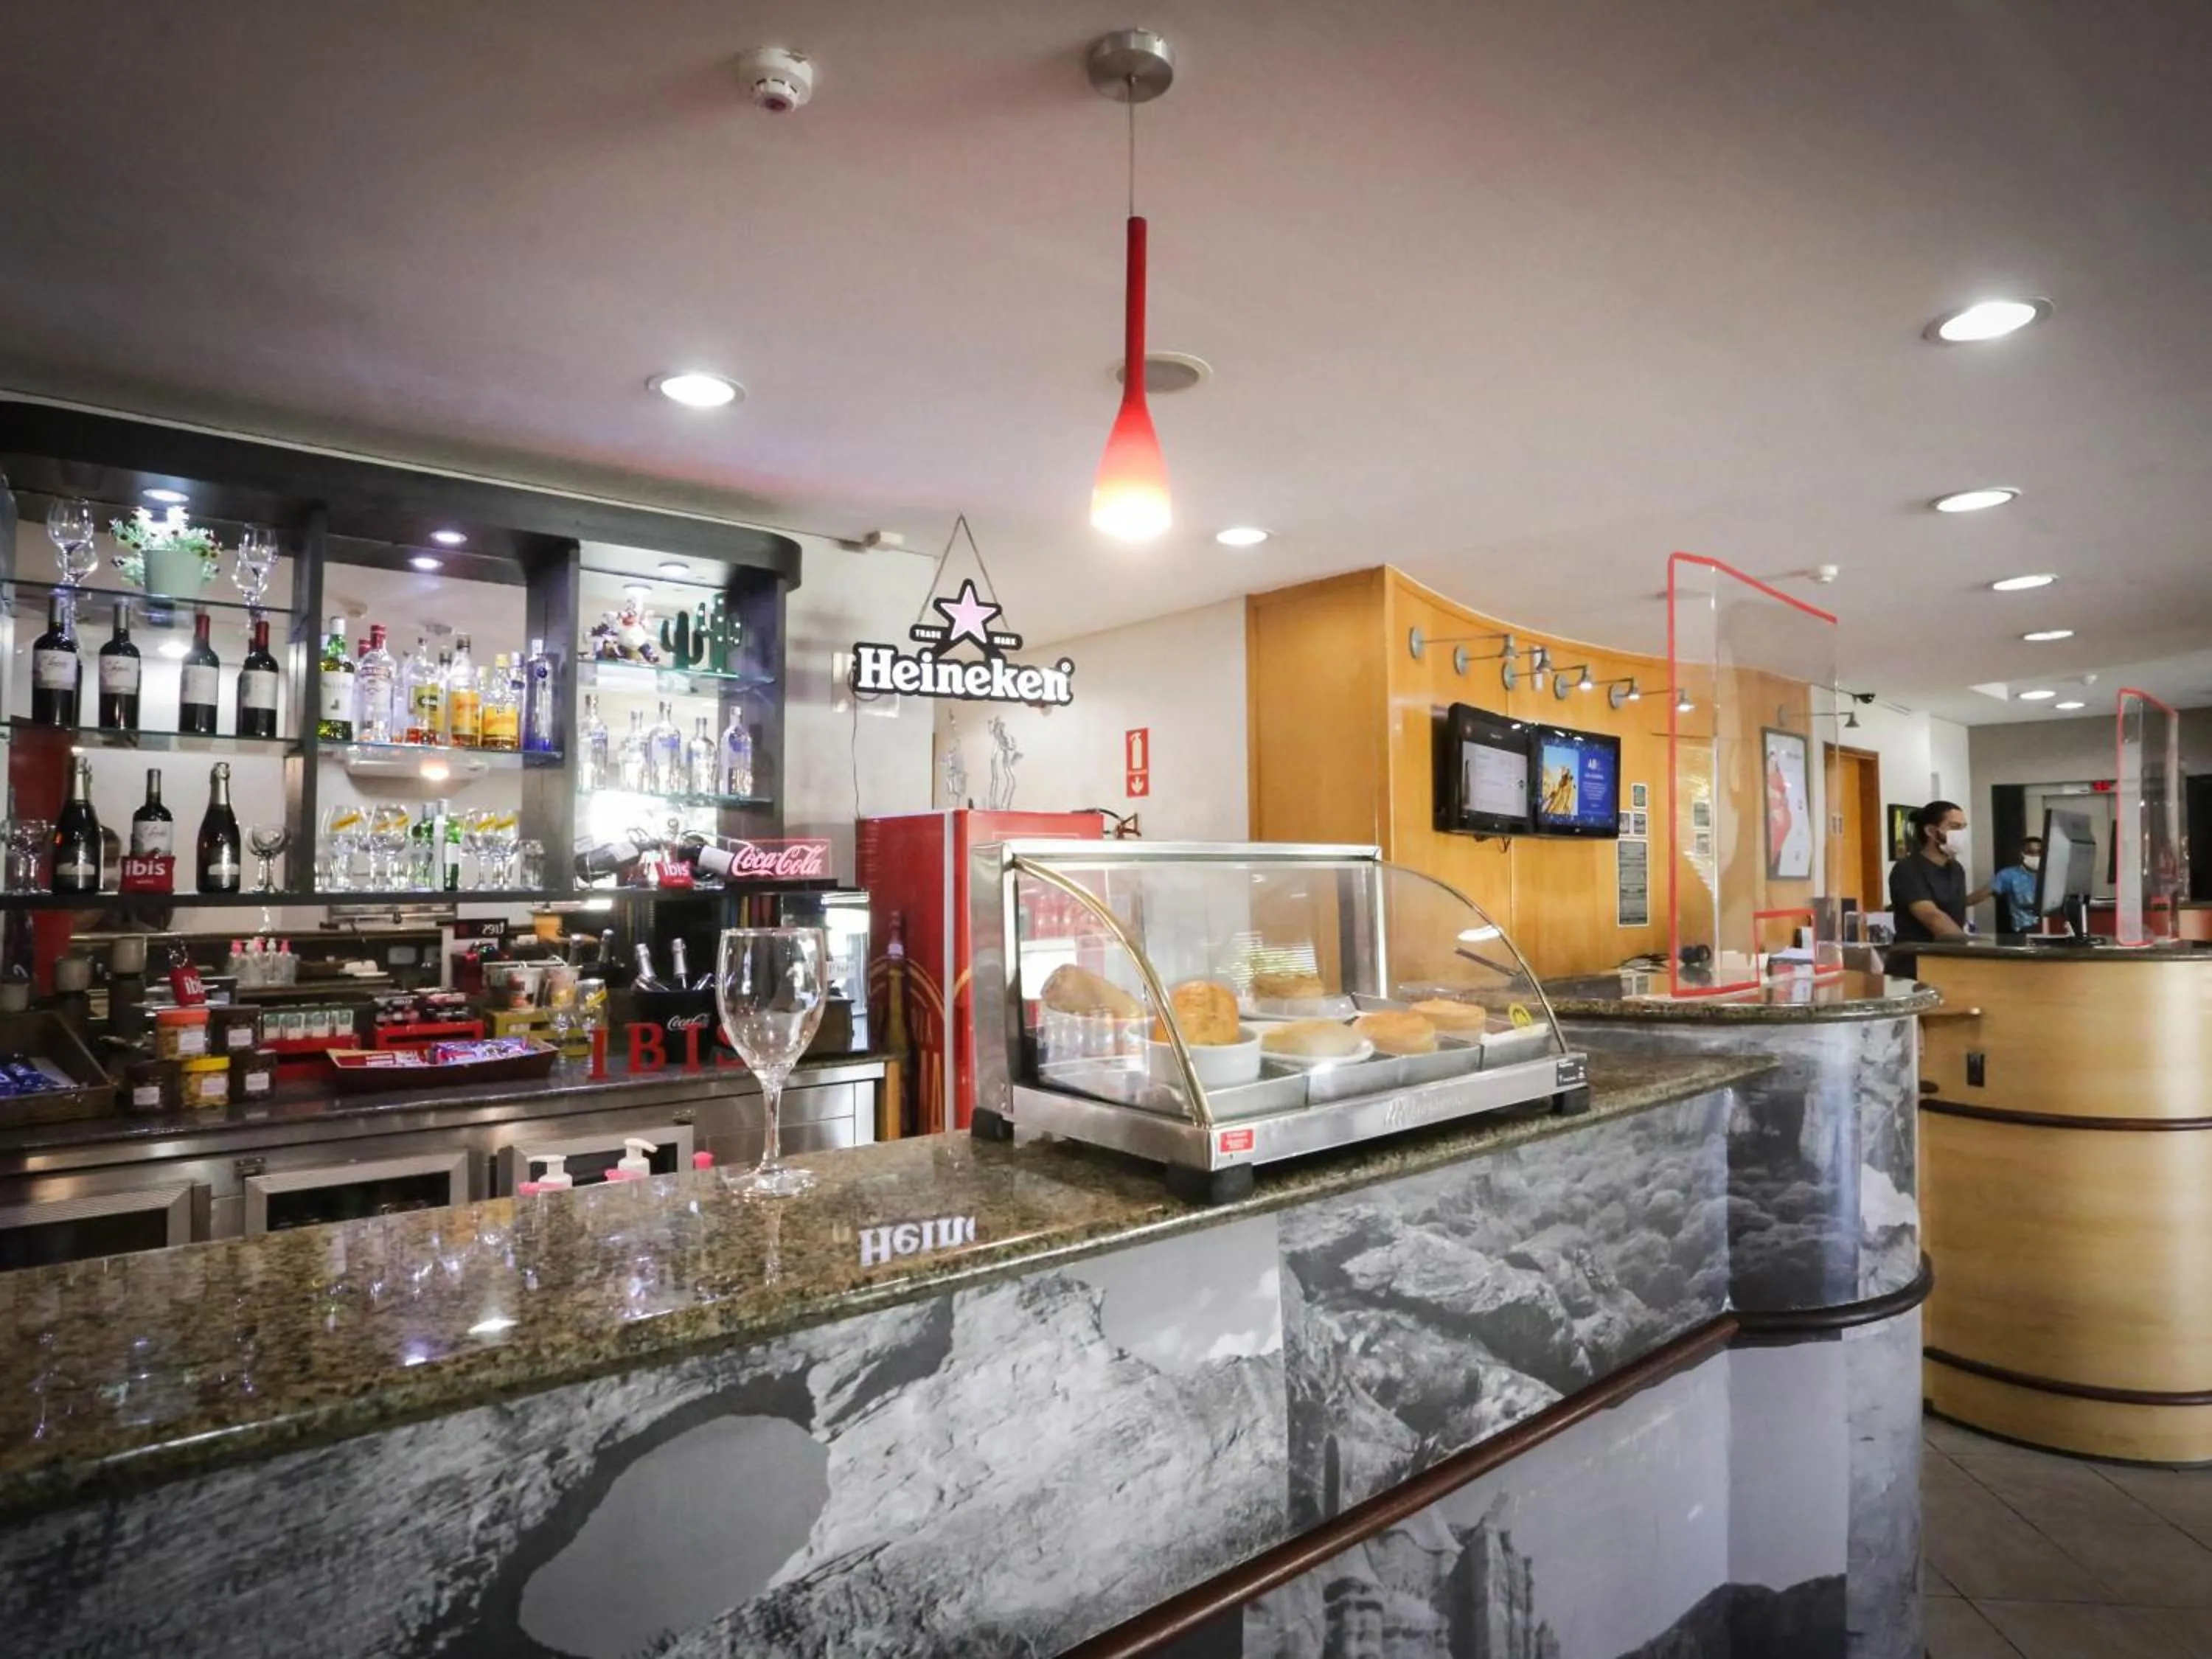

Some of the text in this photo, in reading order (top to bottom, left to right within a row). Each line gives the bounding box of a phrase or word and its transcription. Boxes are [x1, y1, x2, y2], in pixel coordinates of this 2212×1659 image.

[915, 629, 942, 639] TRADE
[858, 647, 1071, 701] Heineken
[125, 860, 166, 877] ibis
[664, 861, 689, 877] ibis
[731, 844, 826, 877] Coca-Cola
